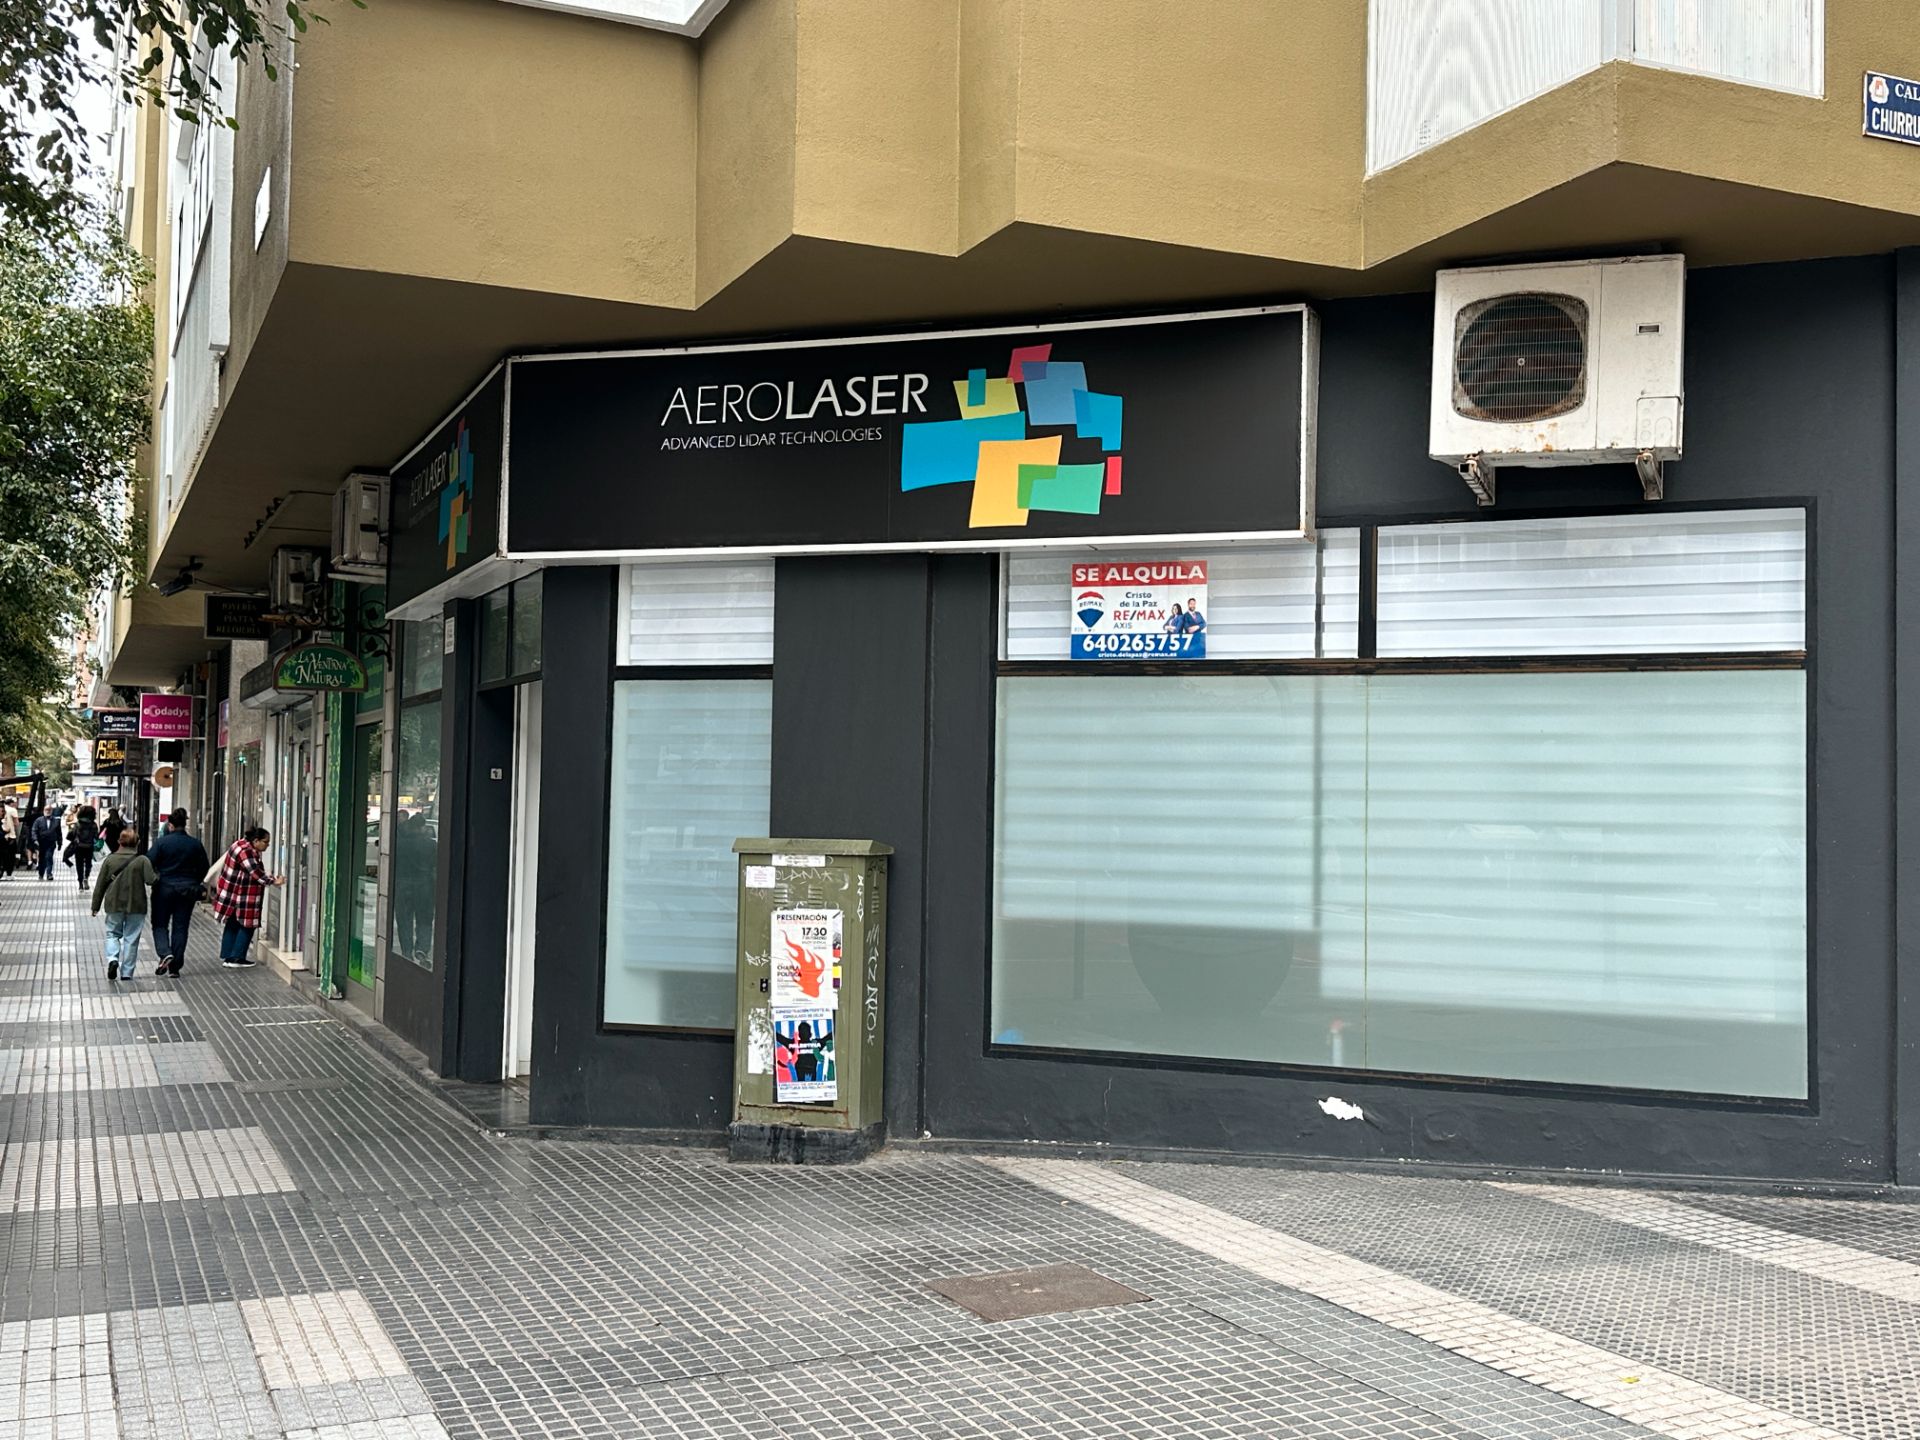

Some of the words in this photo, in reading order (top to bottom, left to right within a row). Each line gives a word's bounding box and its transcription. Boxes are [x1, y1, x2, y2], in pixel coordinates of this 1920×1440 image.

[1894, 83, 1920, 101] CAL
[660, 373, 929, 427] AEROLASER
[660, 434, 736, 451] ADVANCED
[739, 432, 777, 448] LIDAR
[780, 426, 883, 446] TECHNOLOGIES
[1075, 567, 1099, 582] SE
[1104, 565, 1205, 583] ALQUILA
[1125, 591, 1152, 599] Cristo
[1119, 600, 1129, 608] de
[1132, 600, 1140, 608] la
[1142, 600, 1158, 608] Paz
[1113, 609, 1165, 621] RE/MAX
[1113, 622, 1133, 630] AXIS
[1082, 634, 1194, 652] 640265757
[776, 913, 828, 921] PRESENTACIÓN
